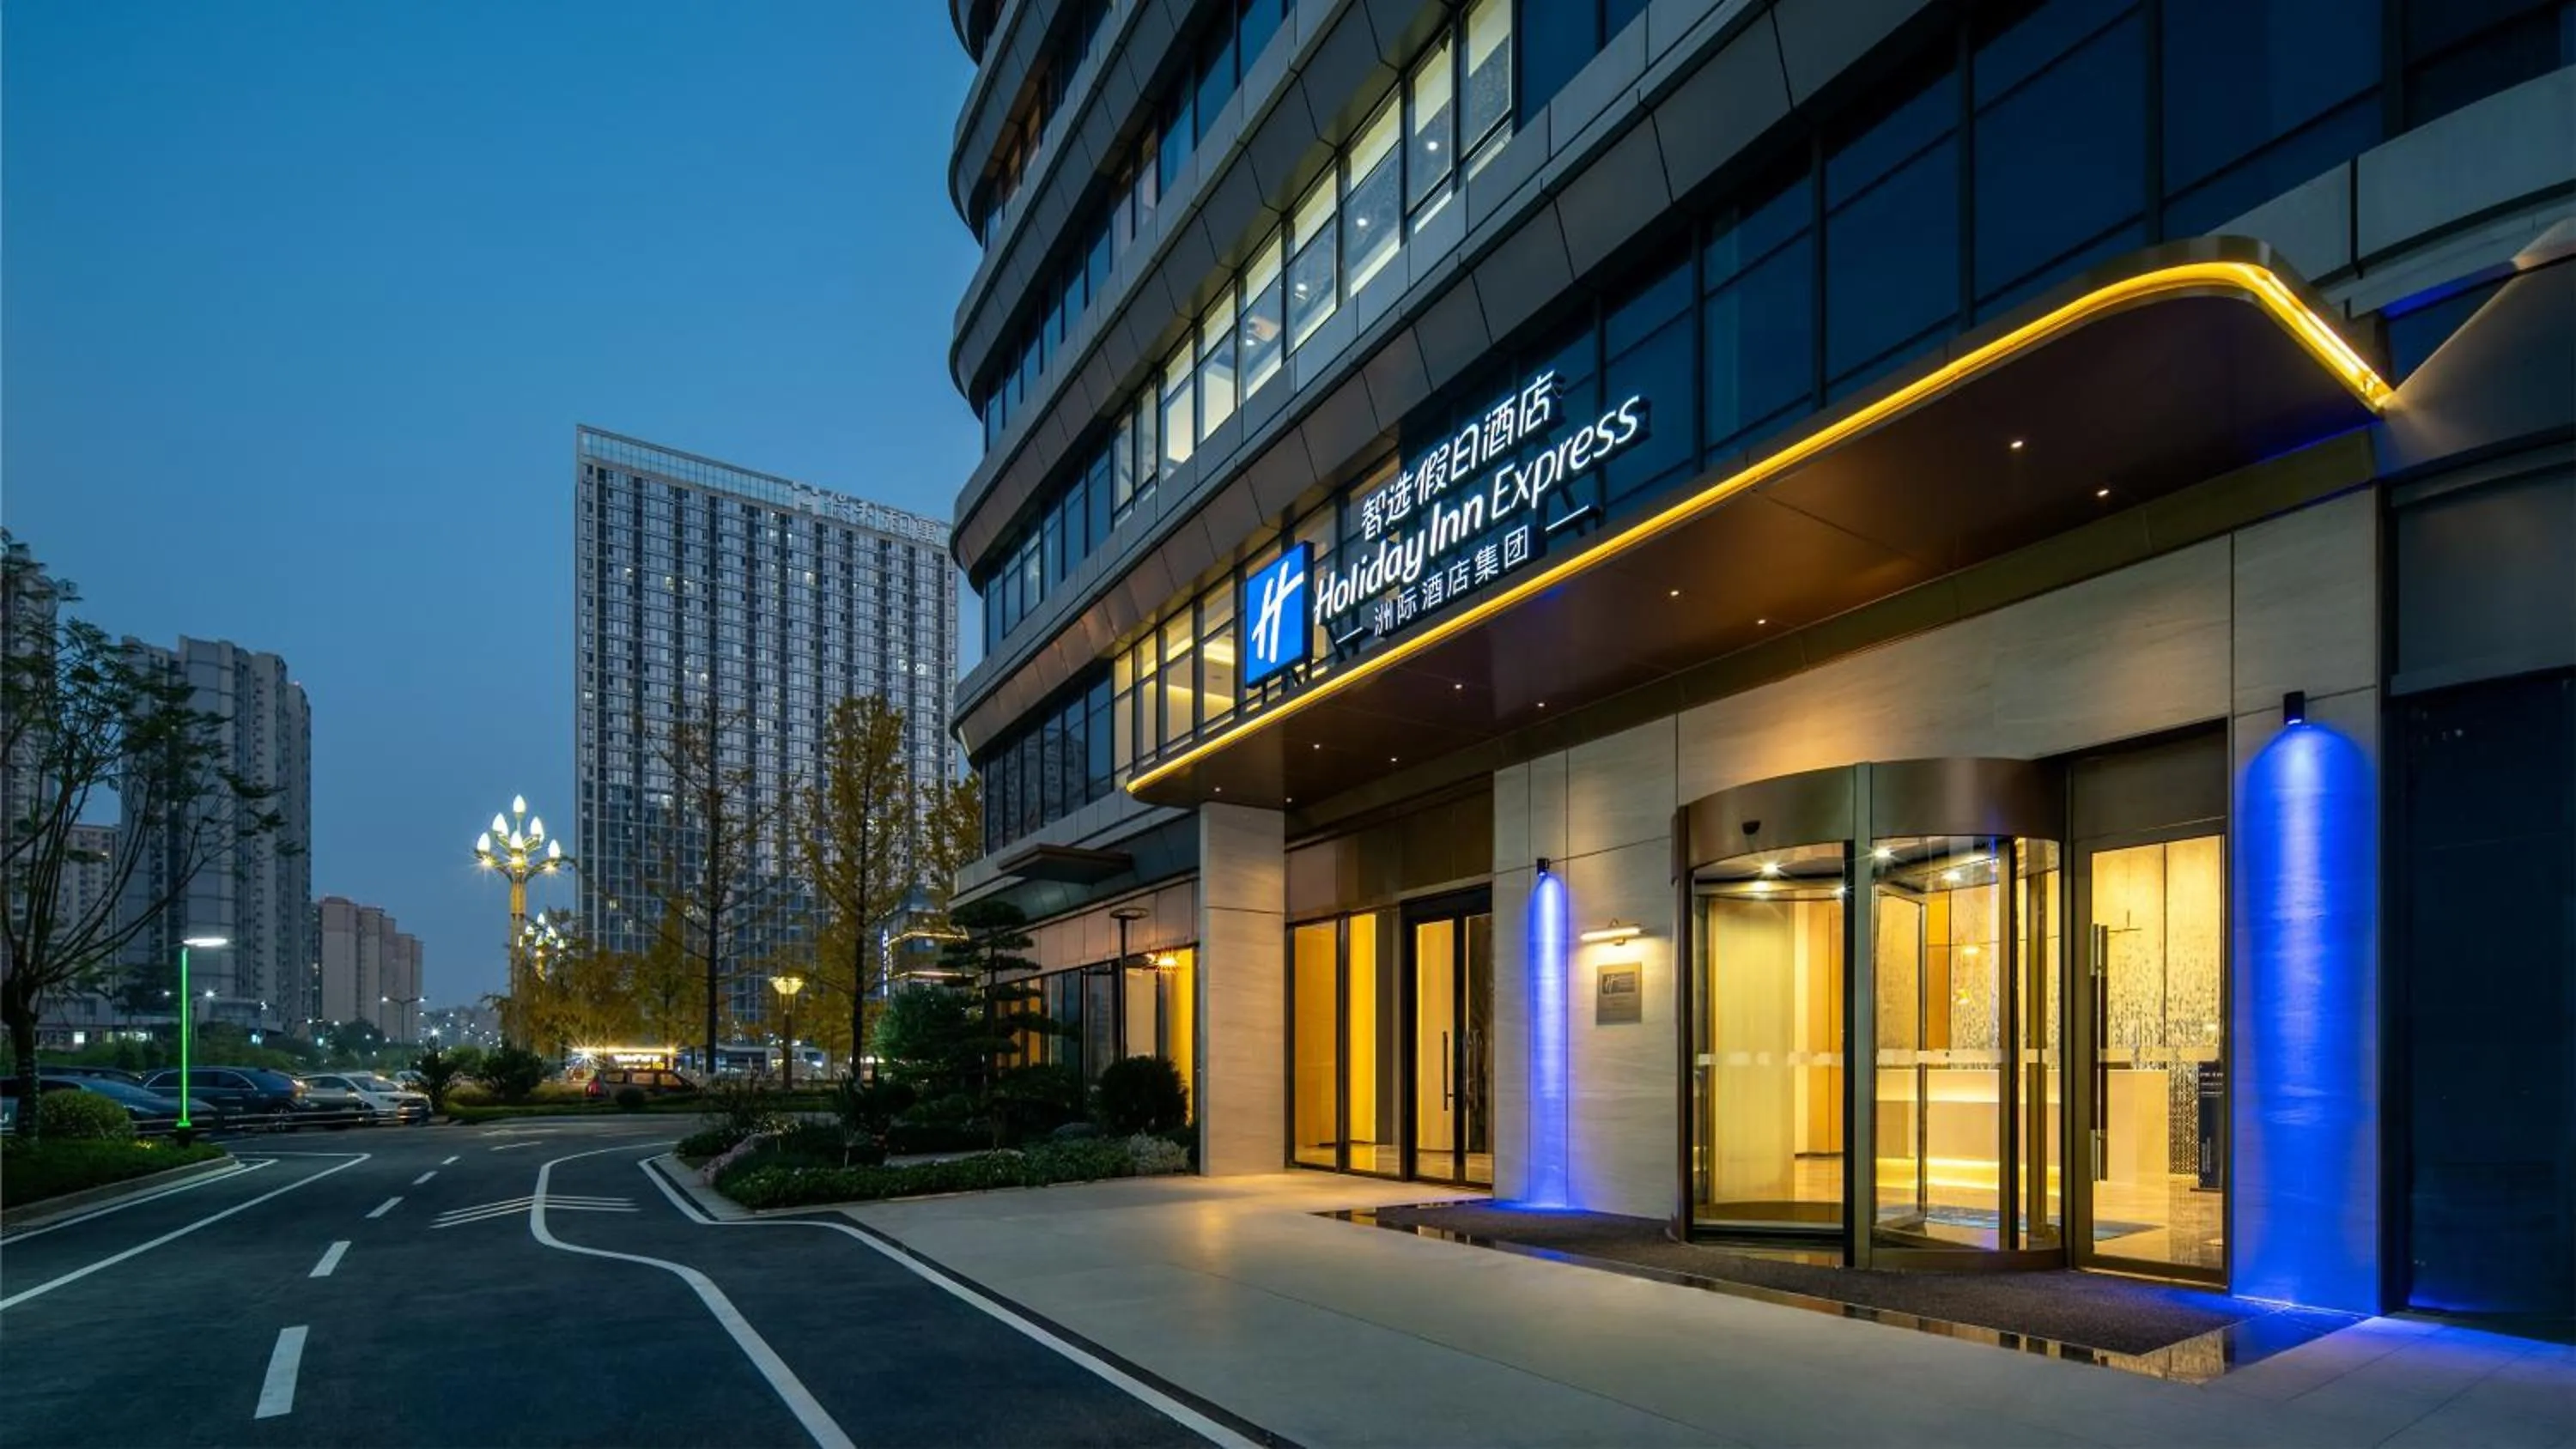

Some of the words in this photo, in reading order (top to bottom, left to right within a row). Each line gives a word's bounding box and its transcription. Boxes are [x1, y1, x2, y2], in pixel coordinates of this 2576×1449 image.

[1314, 529, 1425, 625] Holiday
[1430, 494, 1484, 557] Inn
[1492, 395, 1640, 520] Express
[1361, 370, 1555, 541] 智选假日酒店
[1374, 524, 1528, 637] 洲际酒店集团
